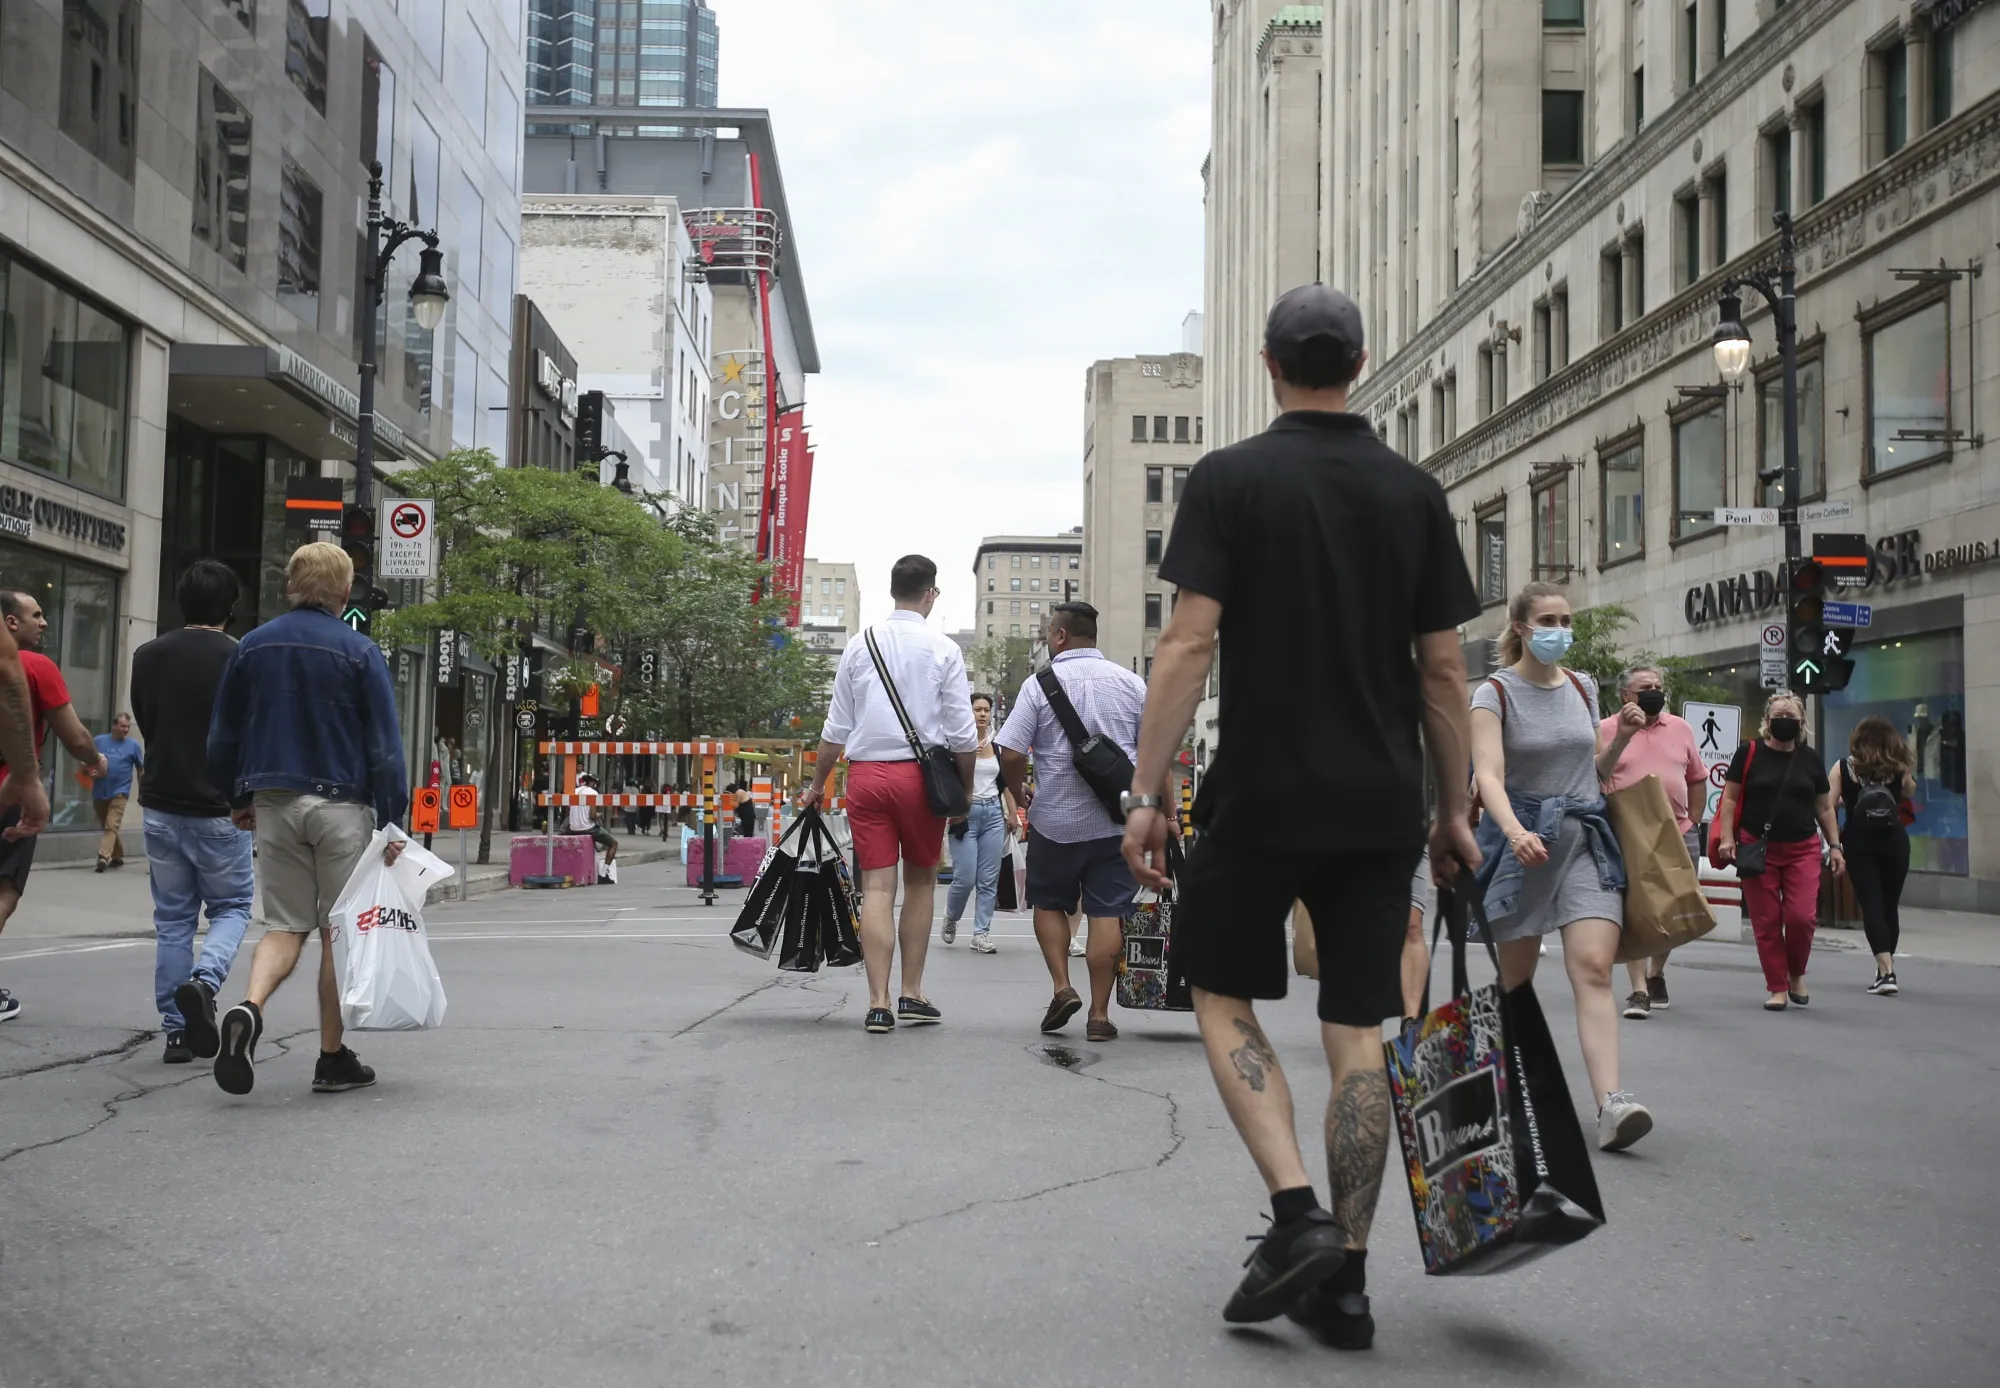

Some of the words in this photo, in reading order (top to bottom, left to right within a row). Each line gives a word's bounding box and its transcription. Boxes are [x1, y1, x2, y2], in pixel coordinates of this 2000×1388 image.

[287, 353, 337, 406] AMERICAN
[339, 387, 359, 419] EAGL
[1400, 359, 1433, 402] BUILDING
[778, 447, 789, 481] Scotia
[0, 484, 33, 517] GLE
[776, 482, 788, 526] Banque
[1806, 506, 1850, 520] Sainte-Catherine
[34, 497, 126, 552] OUTFITTERS
[1725, 514, 1751, 523] Peel
[390, 541, 403, 549] 19h
[413, 541, 422, 549] 7h
[1924, 541, 1987, 573] DEPUIS
[438, 629, 454, 683] Roots
[811, 636, 835, 645] EATON
[506, 654, 520, 701] Roots
[1129, 941, 1161, 965] Browns
[1418, 1109, 1497, 1168] Browns
